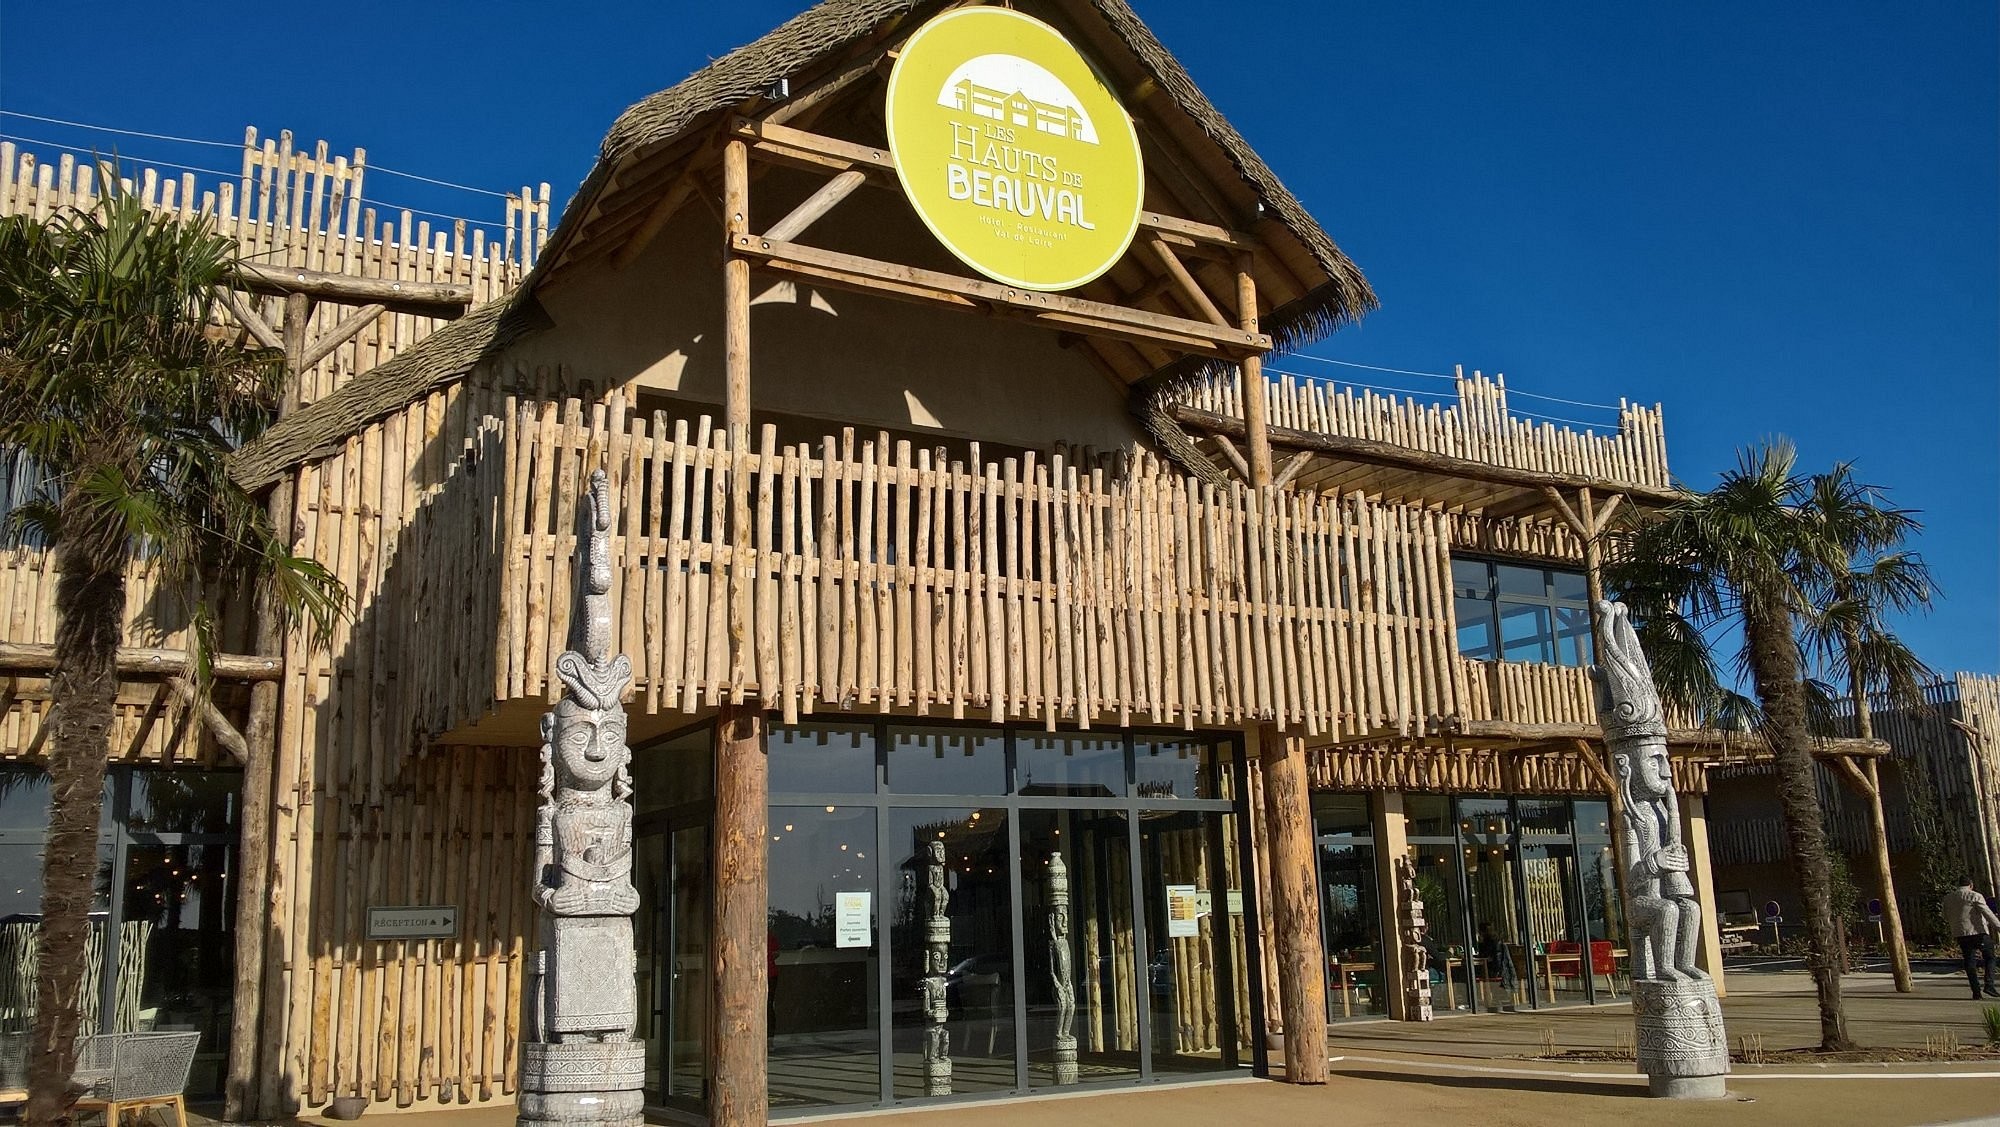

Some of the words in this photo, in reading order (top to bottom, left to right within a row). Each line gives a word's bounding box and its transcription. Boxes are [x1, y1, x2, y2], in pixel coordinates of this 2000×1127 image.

[984, 123, 1015, 143] LES
[949, 121, 1057, 182] HAUTS
[1062, 171, 1082, 188] DE
[947, 163, 1096, 230] BEAUVAL
[994, 228, 1010, 239] Val
[1014, 232, 1025, 241] de
[1029, 236, 1053, 248] Loire
[1017, 222, 1067, 240] Restaurant
